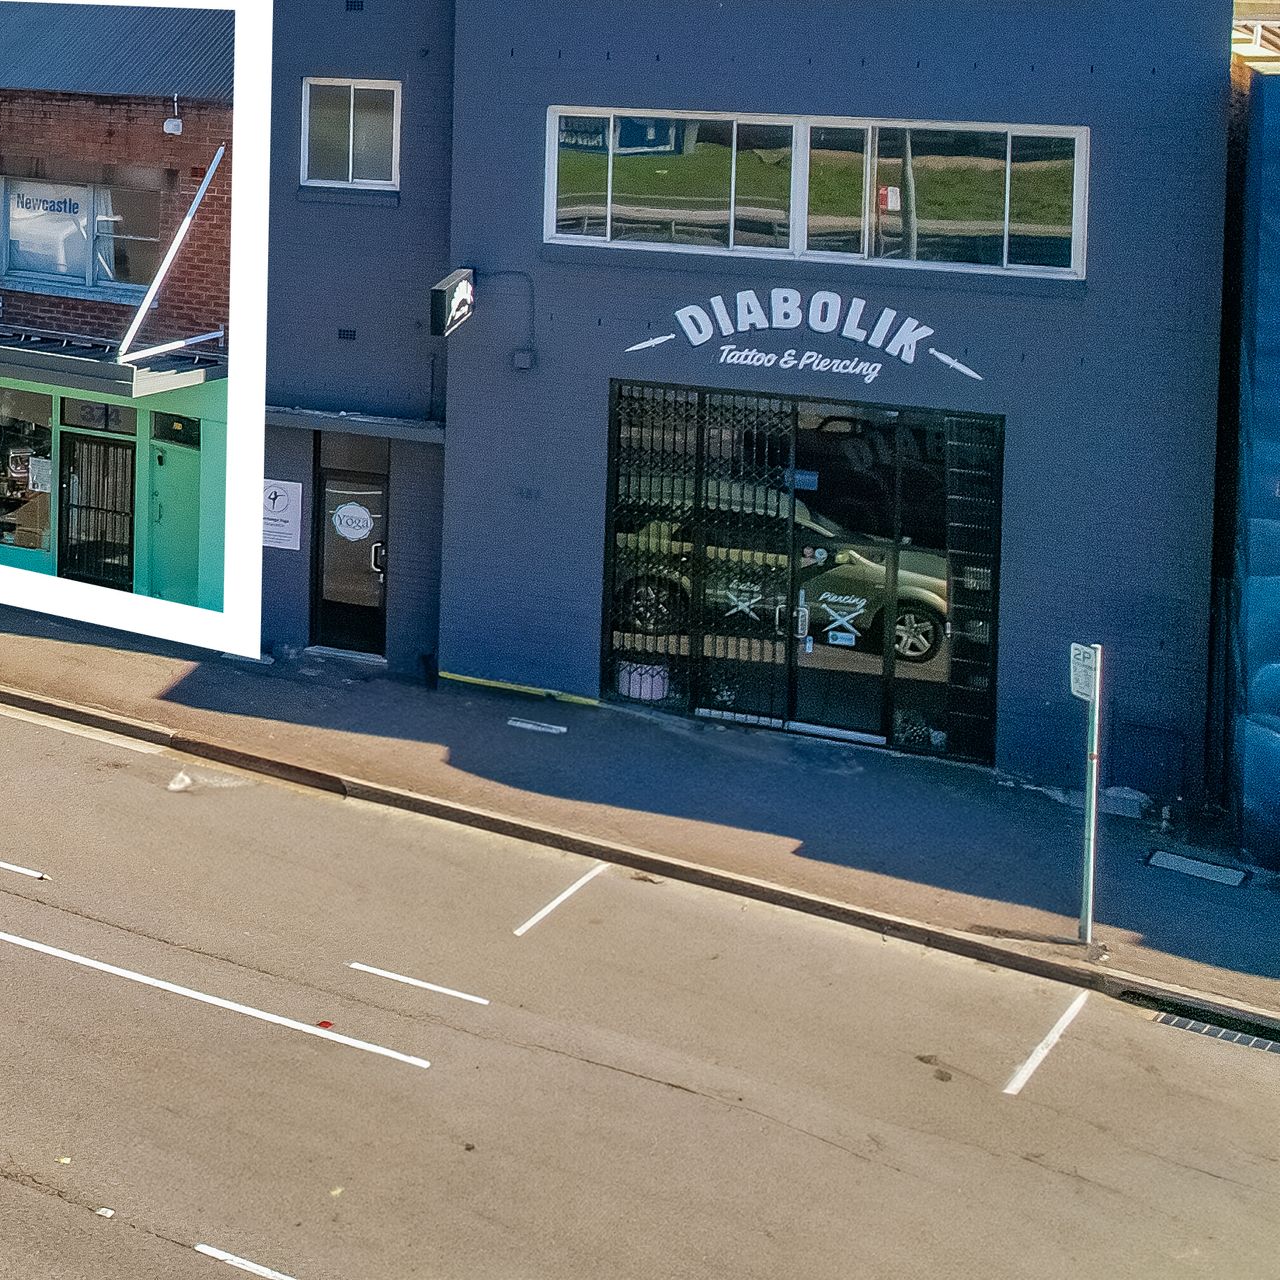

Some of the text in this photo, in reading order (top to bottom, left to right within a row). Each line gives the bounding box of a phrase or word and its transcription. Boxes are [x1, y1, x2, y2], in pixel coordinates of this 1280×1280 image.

[16, 193, 79, 215] Newcastle
[675, 287, 935, 364] DIABOLIK
[719, 344, 883, 384] Tattoo & Piercing
[337, 513, 369, 531] Yoga
[819, 591, 868, 611] Piercing
[1073, 648, 1092, 662] 2P
